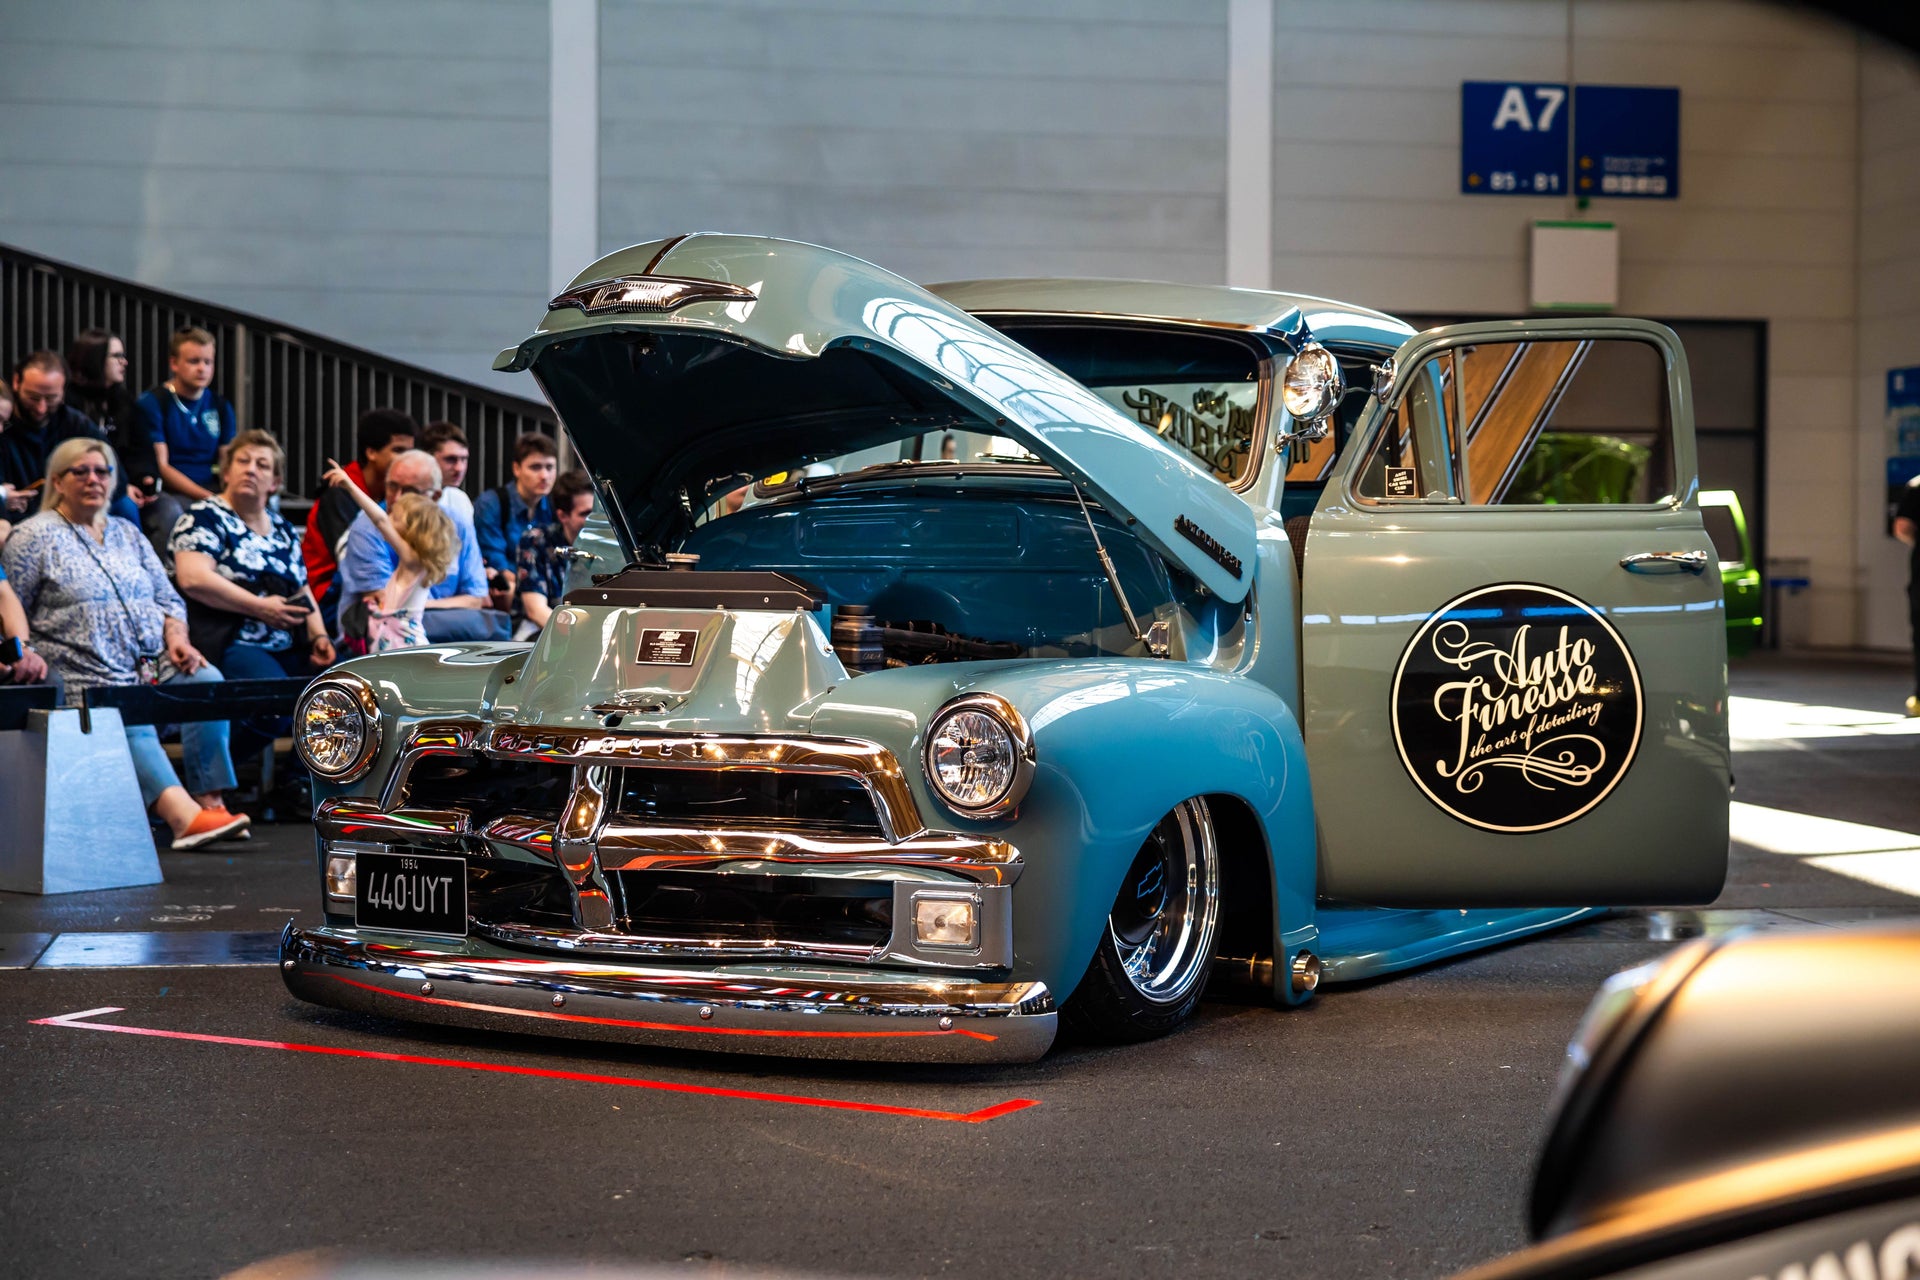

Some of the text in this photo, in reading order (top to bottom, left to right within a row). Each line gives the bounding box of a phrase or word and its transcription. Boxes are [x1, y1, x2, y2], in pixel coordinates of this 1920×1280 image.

[1492, 87, 1566, 132] A7
[1433, 621, 1596, 700] Auto
[496, 732, 705, 758] CHEVROLET
[1434, 665, 1597, 777] Finesse
[1469, 702, 1604, 758] the art of detailing
[401, 858, 419, 870] 1954
